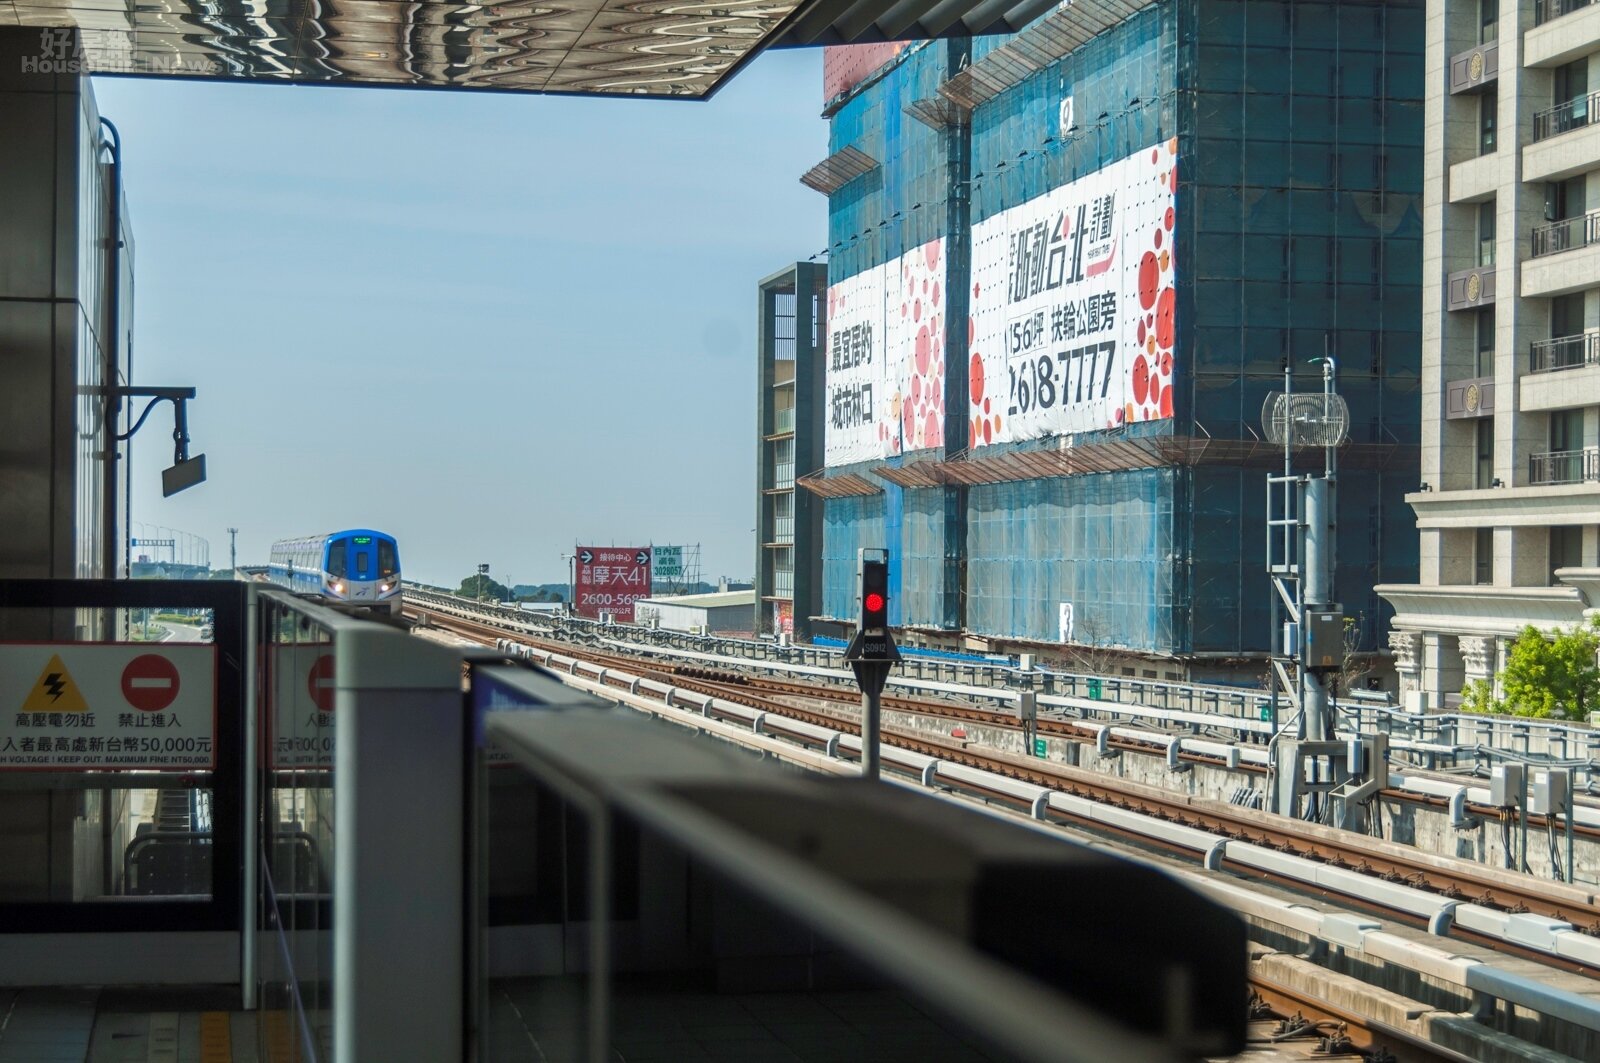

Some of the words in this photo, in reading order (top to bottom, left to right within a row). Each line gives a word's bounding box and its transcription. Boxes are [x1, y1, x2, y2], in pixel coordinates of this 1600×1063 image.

[1051, 290, 1116, 343] 扶輪公園旁
[600, 553, 632, 562] 接待中心
[865, 643, 886, 653] S0912
[16, 713, 96, 728] 高壓電勿近
[118, 713, 182, 728] 禁止進入
[0, 737, 212, 753] 入者最高處新台幣50,000元
[150, 755, 169, 763] FINE
